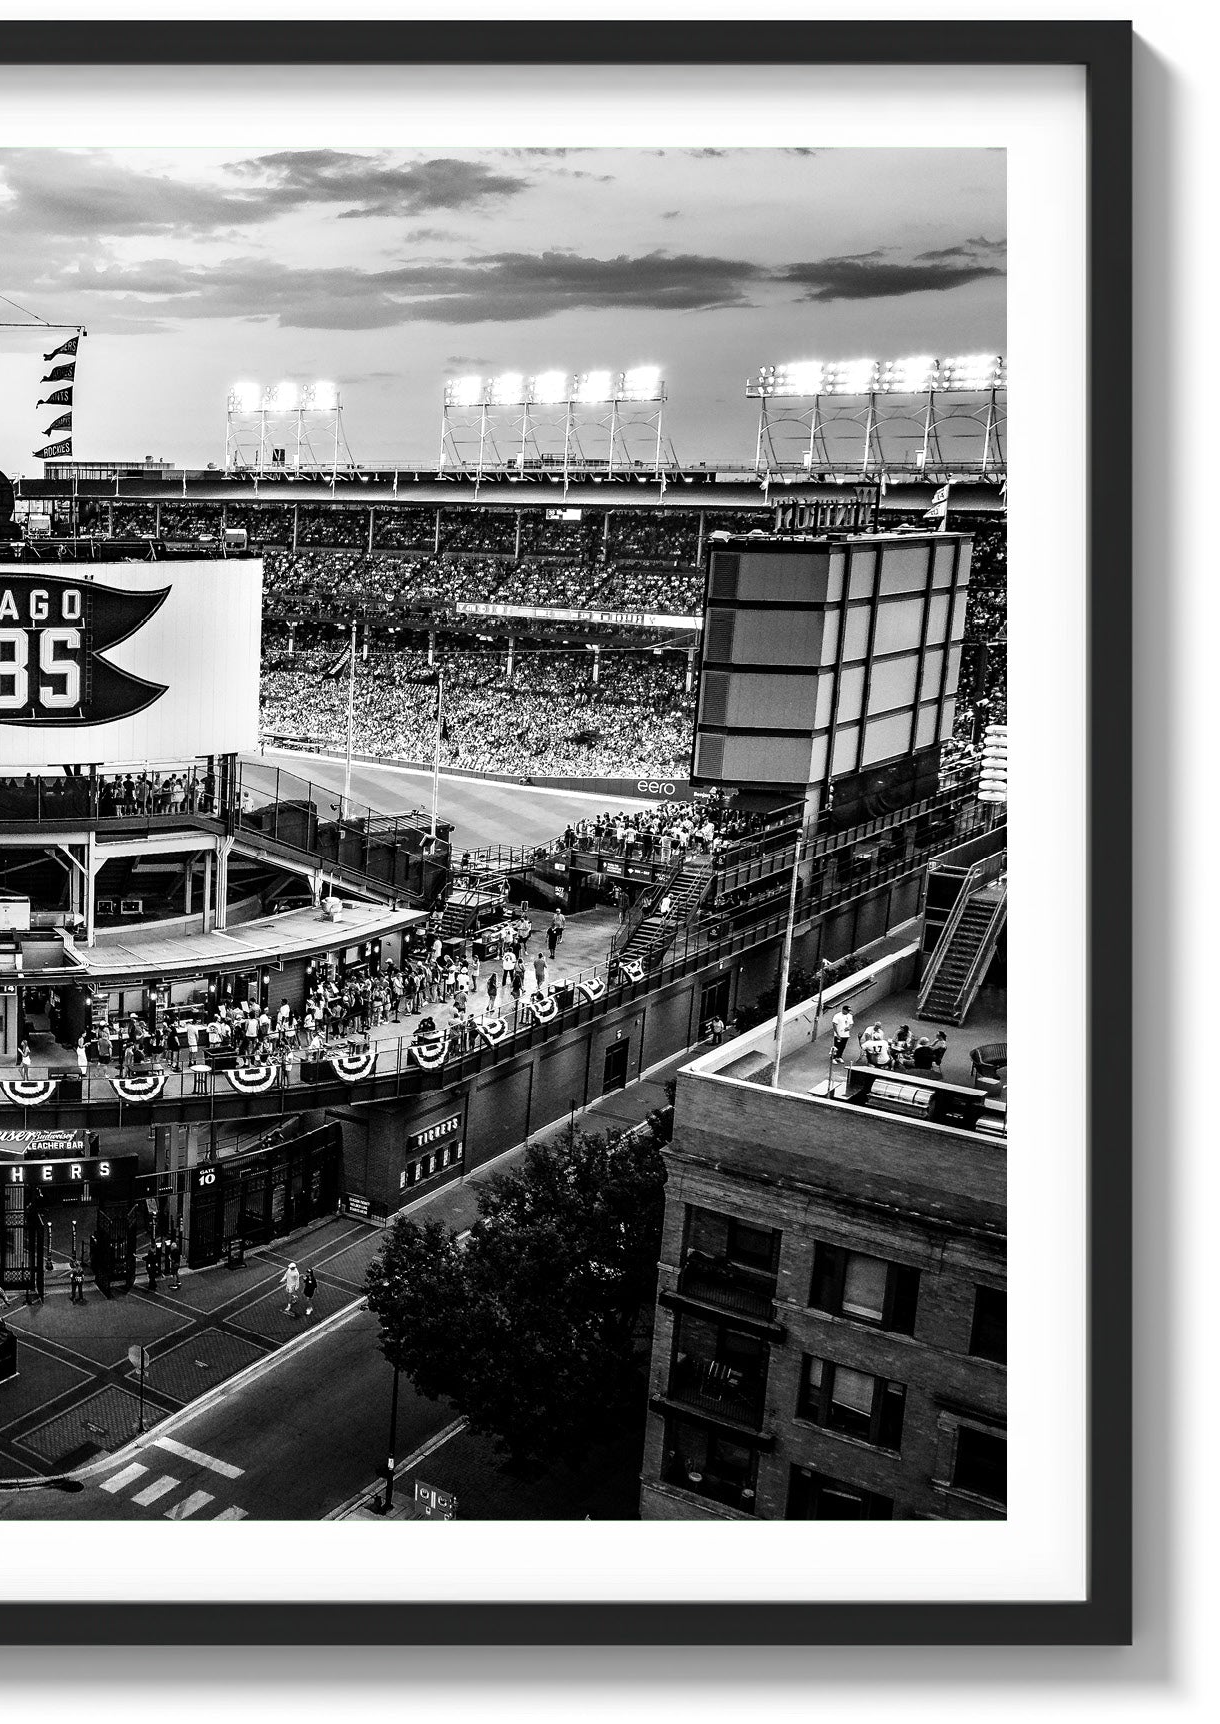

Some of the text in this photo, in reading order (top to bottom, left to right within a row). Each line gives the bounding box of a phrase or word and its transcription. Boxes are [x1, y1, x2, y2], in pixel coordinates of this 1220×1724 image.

[50, 391, 69, 402] ANTS
[43, 442, 70, 457] ROCKIES
[637, 780, 676, 796] eero
[3, 985, 16, 993] 14
[872, 1045, 883, 1053] 17
[417, 1117, 459, 1147] TICKETS
[66, 1140, 84, 1150] BAR
[199, 1167, 216, 1175] GATE
[198, 1173, 216, 1186] 10
